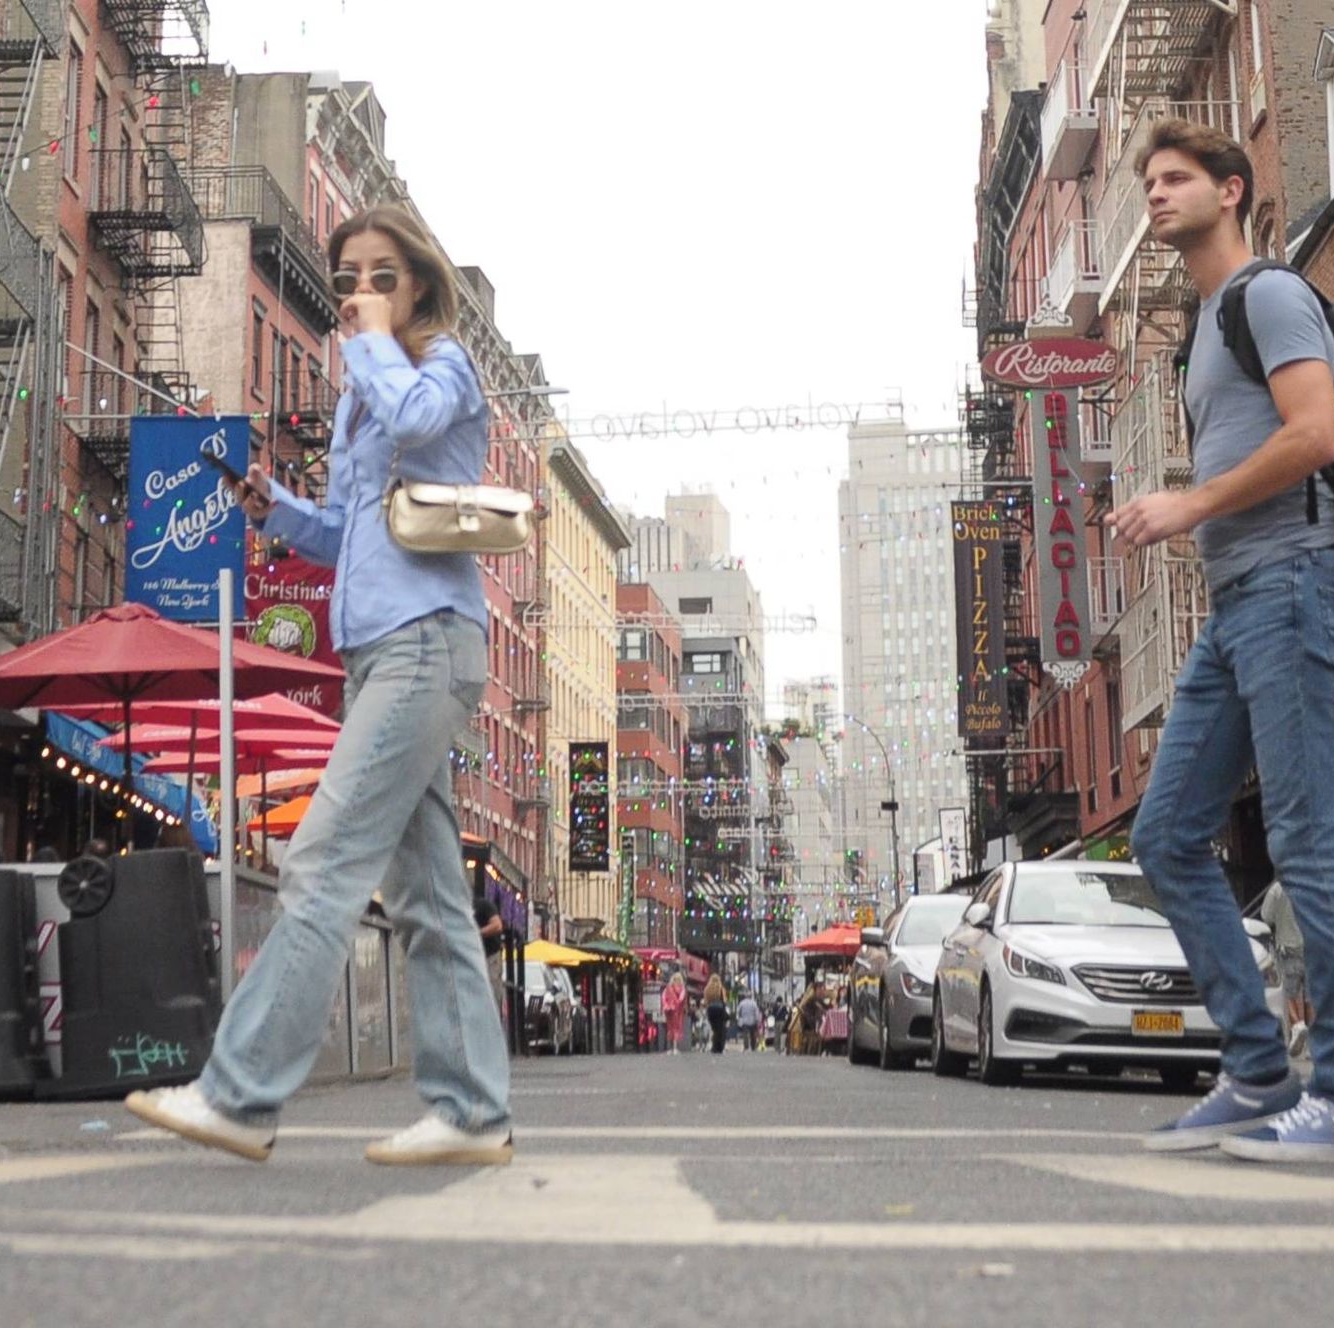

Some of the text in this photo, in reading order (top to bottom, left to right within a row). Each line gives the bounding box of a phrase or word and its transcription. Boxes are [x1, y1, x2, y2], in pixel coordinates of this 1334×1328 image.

[994, 342, 1117, 383] Ristorante
[145, 461, 201, 500] Casa
[953, 505, 997, 521] Brick
[954, 522, 1000, 541] Oven
[210, 579, 219, 591] S
[244, 574, 333, 601] Christmas
[156, 594, 180, 607] New
[973, 546, 990, 682] PIZZA
